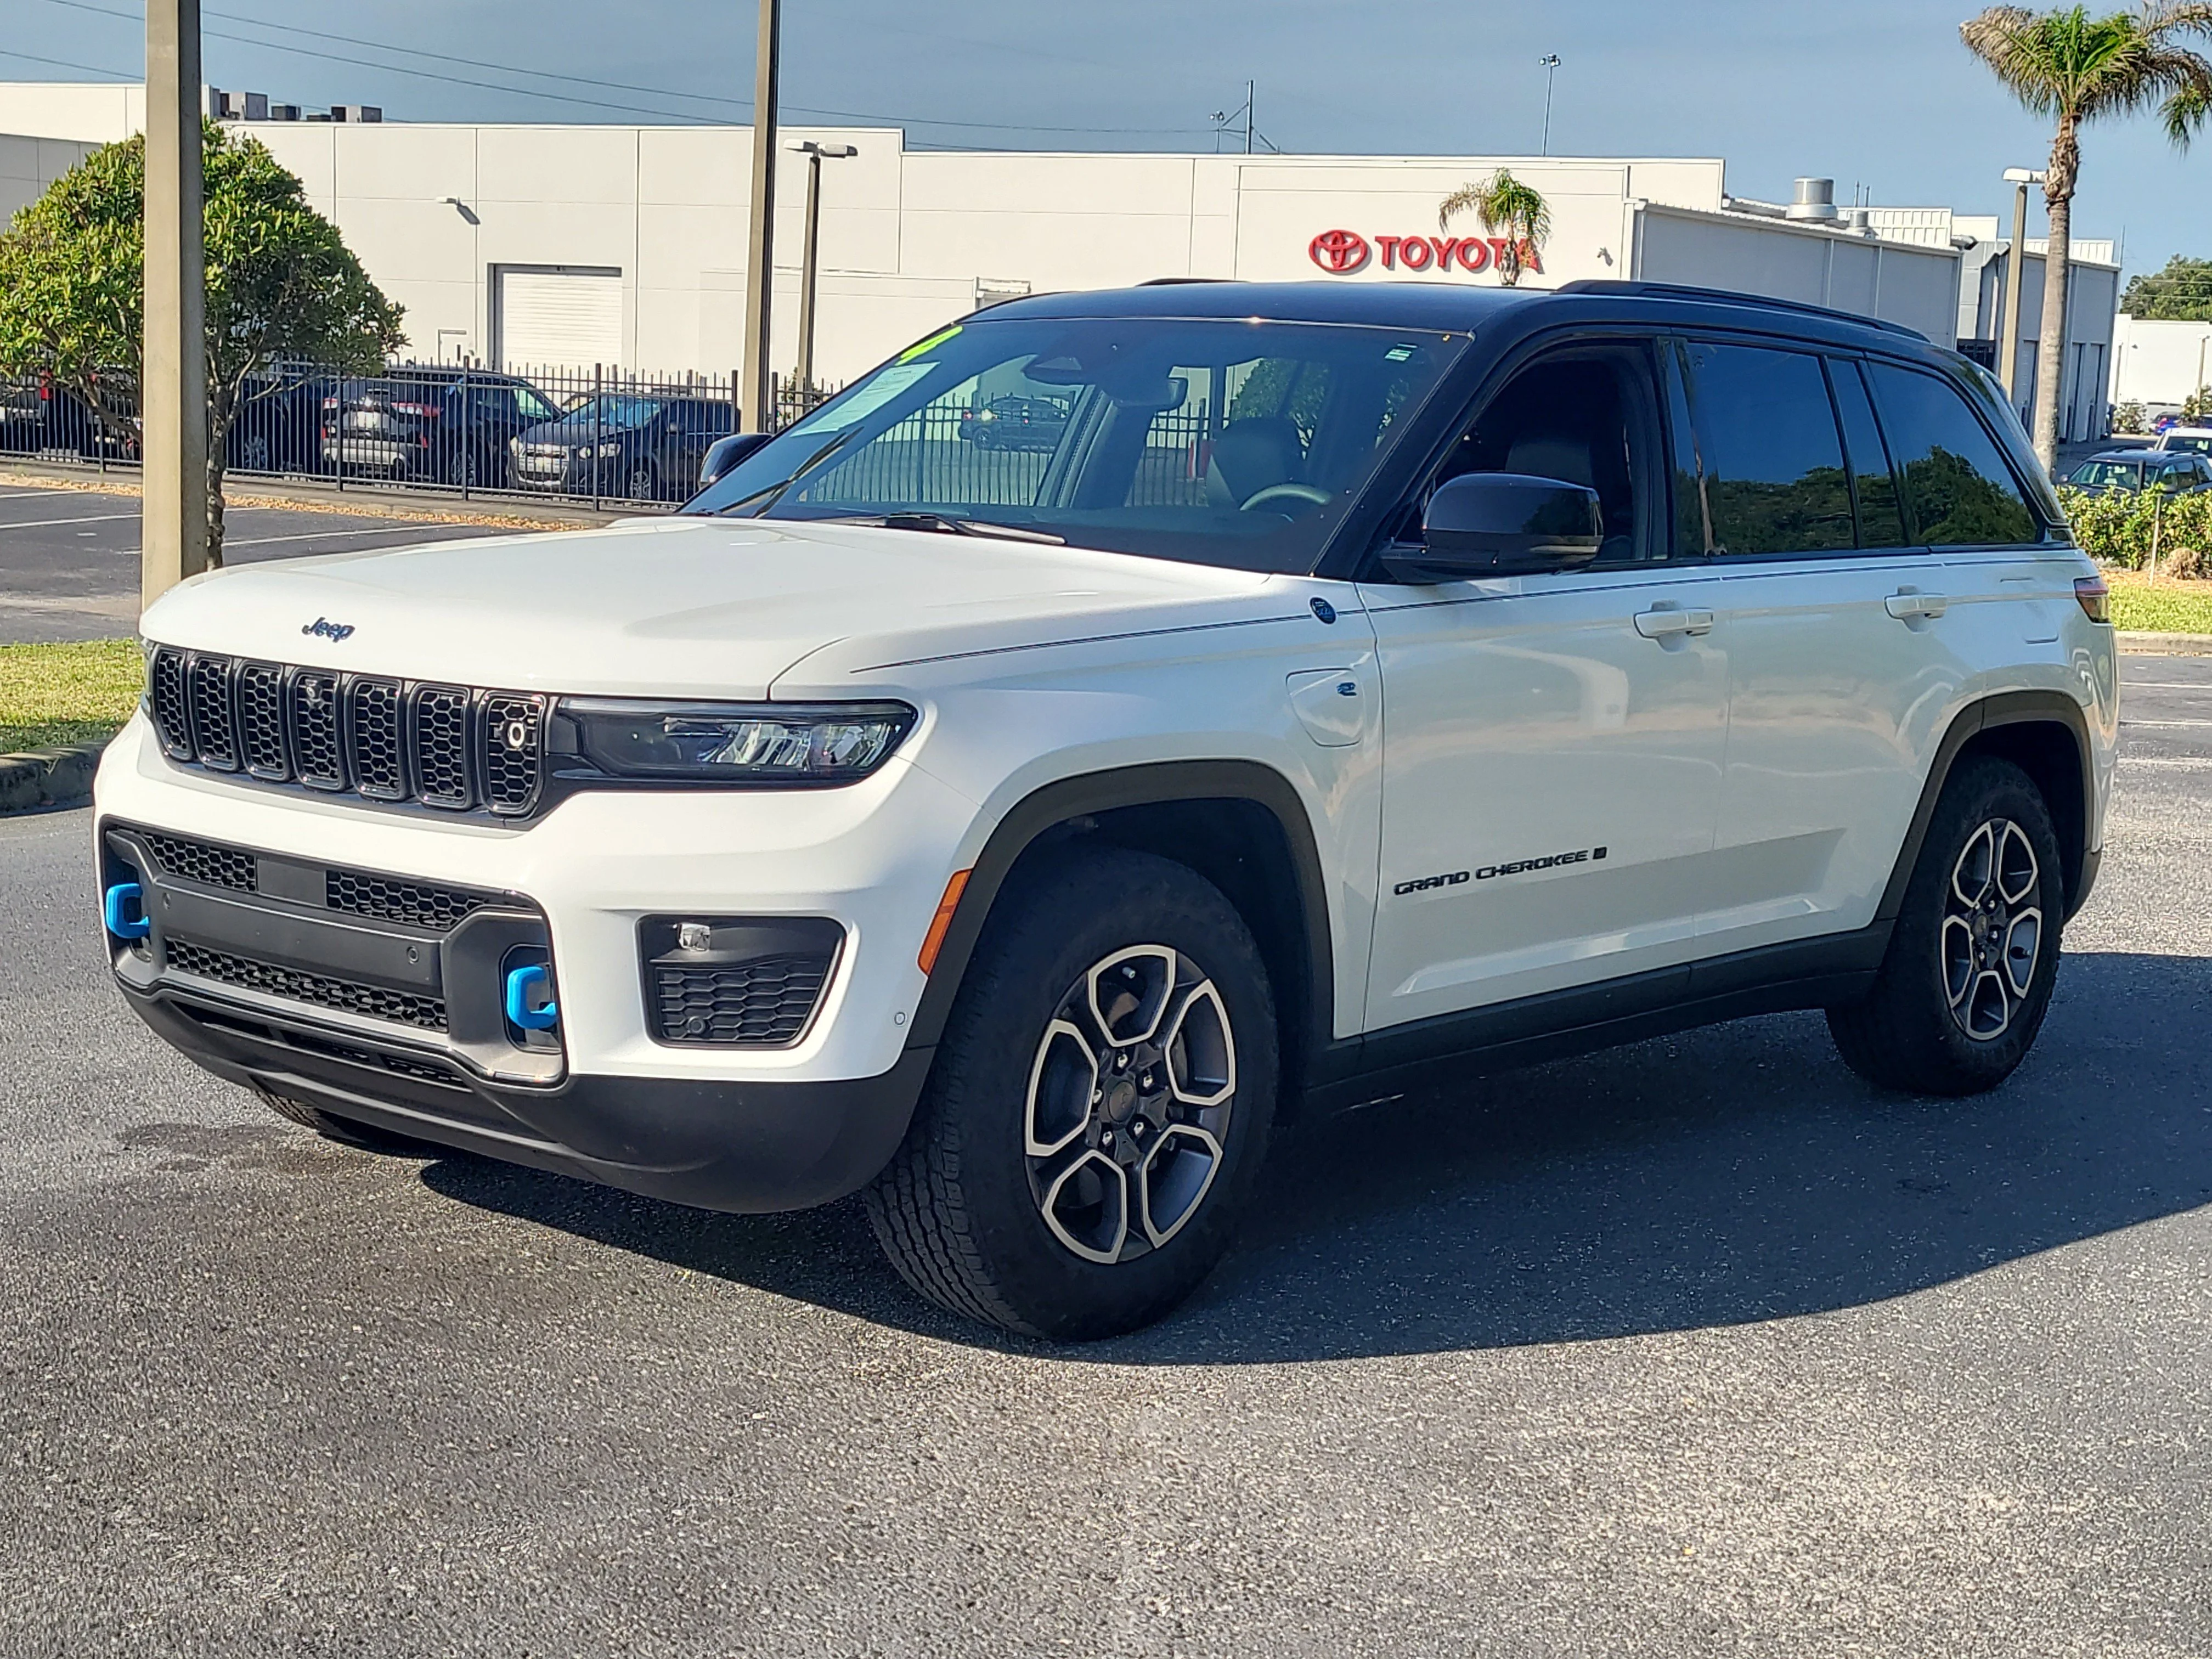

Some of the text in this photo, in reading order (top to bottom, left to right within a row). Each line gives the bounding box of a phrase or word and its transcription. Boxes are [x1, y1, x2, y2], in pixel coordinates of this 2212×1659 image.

[1375, 236, 1540, 270] TOYOTA
[302, 617, 356, 643] Jeep
[1393, 871, 1470, 896] GRAND
[1475, 850, 1589, 879] CHEROKEE
